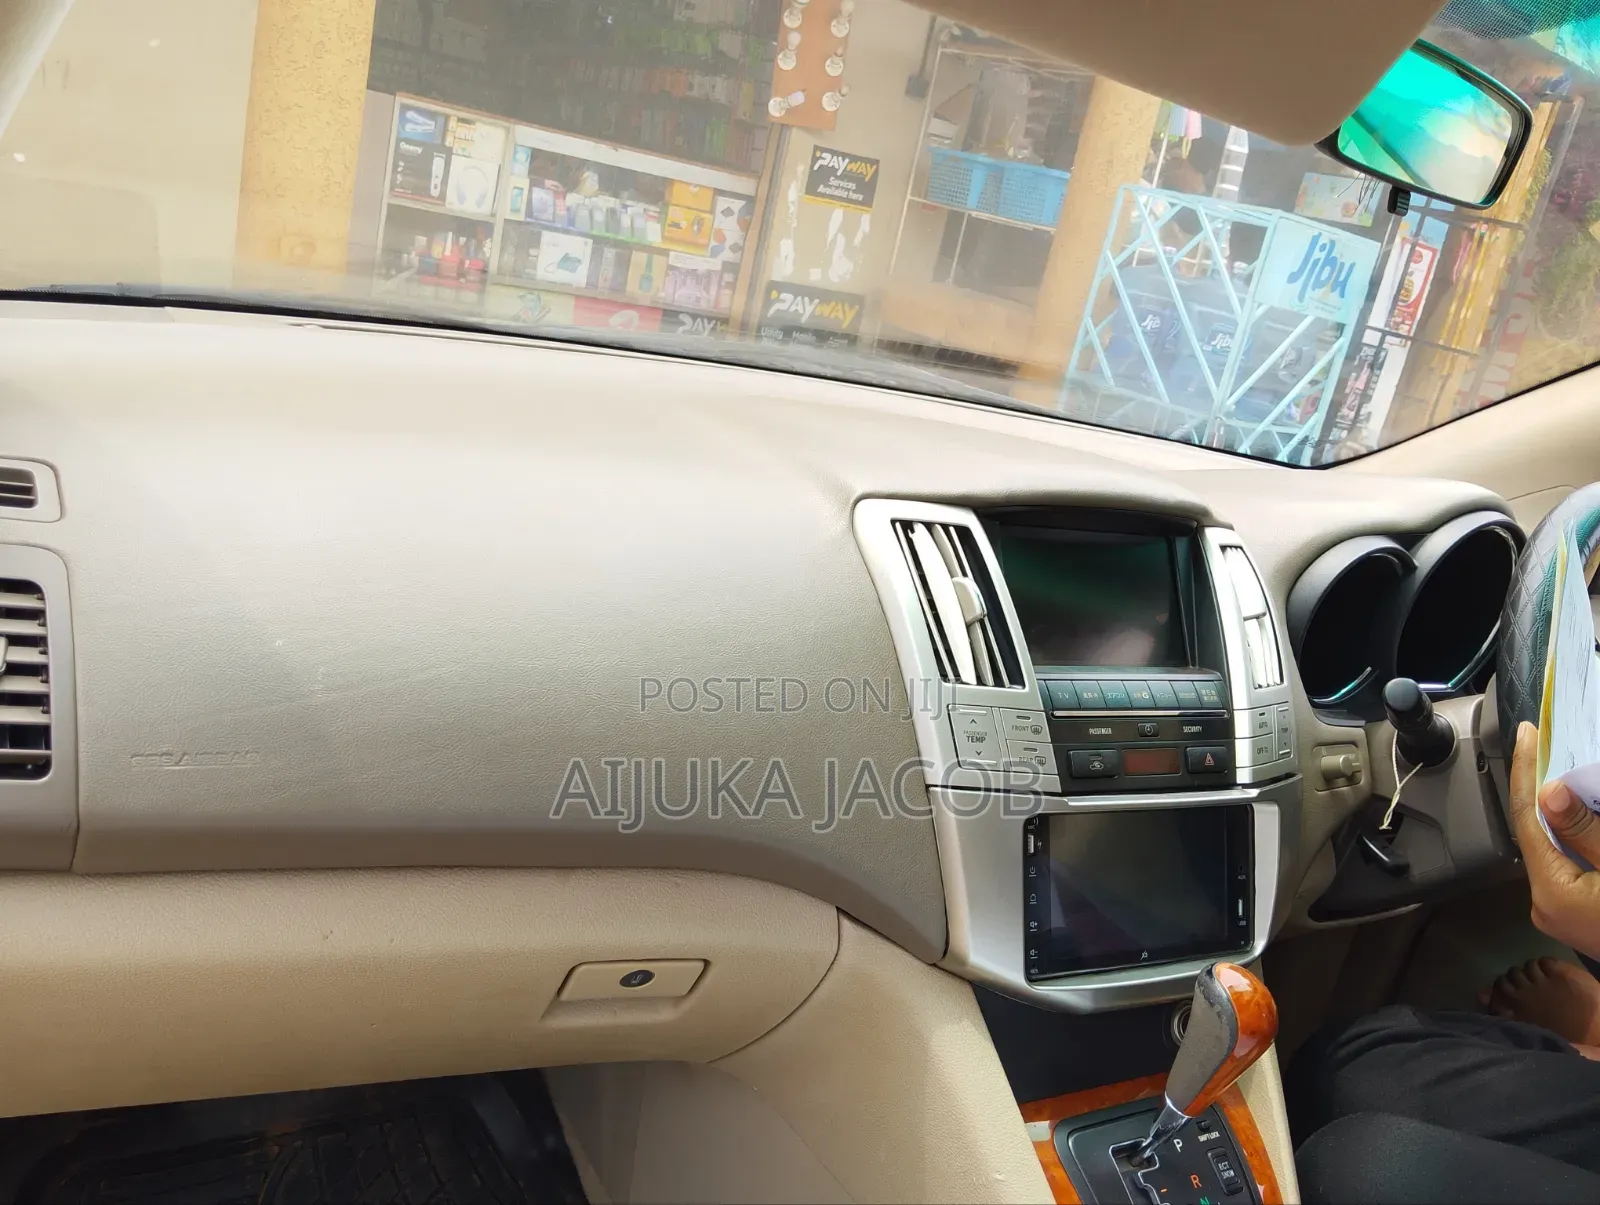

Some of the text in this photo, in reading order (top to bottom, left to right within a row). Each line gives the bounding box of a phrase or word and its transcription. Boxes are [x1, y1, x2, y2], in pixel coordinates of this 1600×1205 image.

[813, 151, 877, 182] PAYWAY
[829, 177, 856, 190] Services
[817, 184, 863, 201] Available here
[1286, 231, 1356, 303] Jibu
[766, 289, 859, 329] PAYWAY
[963, 729, 988, 737] PASSENGER
[1089, 727, 1112, 735] PASSENGER
[1183, 725, 1202, 733] SECURITY
[965, 735, 987, 743] TEMP
[1018, 756, 1034, 764] REAR
[1173, 1138, 1183, 1153] P
[1218, 1161, 1230, 1171] ECT
[1221, 1169, 1235, 1180] SNOW
[1190, 1174, 1203, 1189] R
